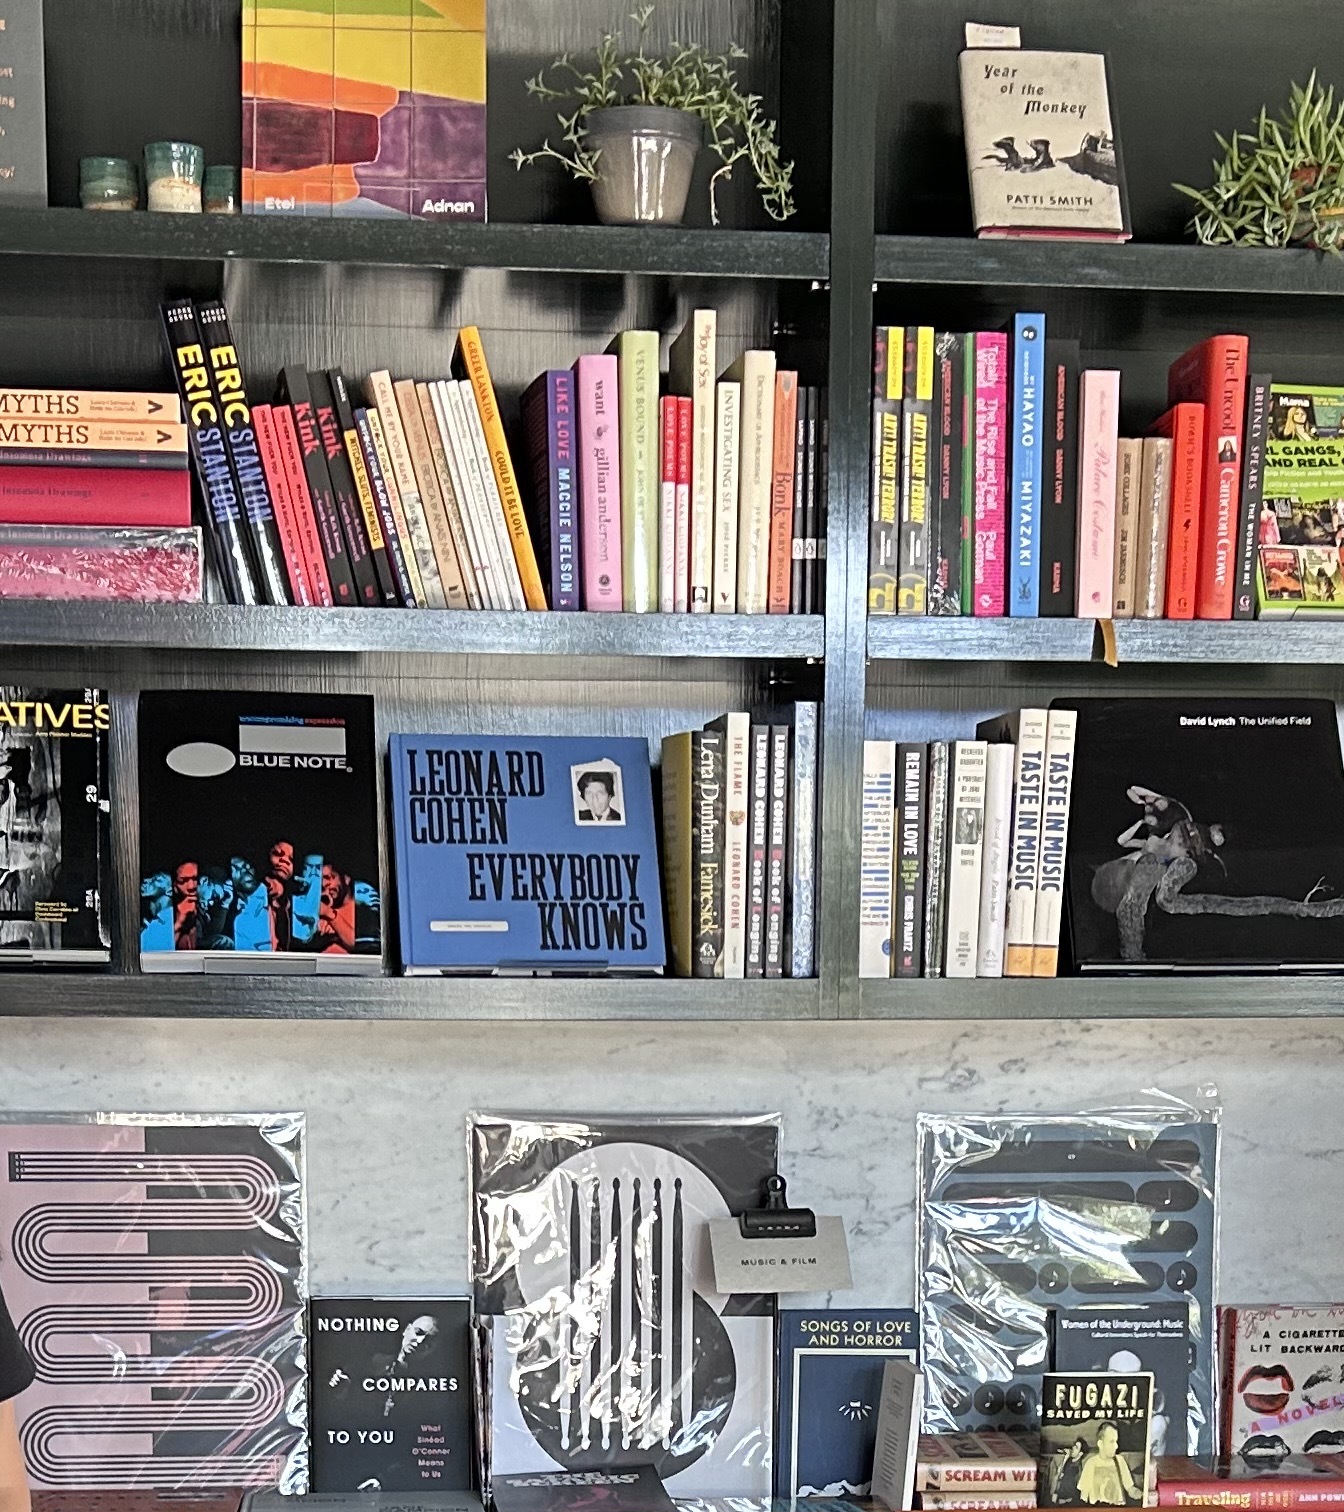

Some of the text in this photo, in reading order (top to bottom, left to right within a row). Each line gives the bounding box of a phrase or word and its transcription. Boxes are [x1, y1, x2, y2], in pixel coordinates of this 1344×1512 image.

[984, 64, 1017, 79] Year
[1001, 83, 1044, 95] of the
[1024, 101, 1086, 119] Monkey
[265, 196, 295, 212] Etel
[421, 198, 475, 215] Adnan
[177, 344, 240, 523] ERIC STANTON
[294, 402, 320, 456] Kink
[1277, 446, 1340, 457] GANGS,
[594, 447, 610, 493] gillian
[1298, 457, 1338, 468] REAL
[557, 377, 573, 593] LIKE LOVE MAGGIE NELSON
[1019, 387, 1035, 567] HAYAO MIYAZAKI
[597, 496, 611, 562] anderson
[1179, 716, 1206, 727] David
[1208, 716, 1235, 727] Lynch
[1258, 716, 1288, 727] Unified
[1290, 716, 1311, 727] Field
[239, 753, 347, 770] BLUE NOTE
[407, 749, 545, 797] LEONARD
[409, 797, 509, 845] COHEN
[1015, 751, 1041, 891] TASTE IN MUSIC
[699, 737, 719, 936] Lena Dunham Famesick
[467, 853, 640, 902] EVERYBODY
[538, 902, 648, 952] KNOWS
[318, 1318, 399, 1332] NOTHING
[800, 1320, 912, 1335] SONGS OF LOVE
[809, 1333, 903, 1348] AND HORROR
[363, 1378, 458, 1391] COMPARES
[1055, 1383, 1138, 1409] FUGAZI
[1046, 1409, 1087, 1420] SAVED
[328, 1430, 394, 1444] TO YOU
[945, 1468, 1007, 1483] SCREAM
